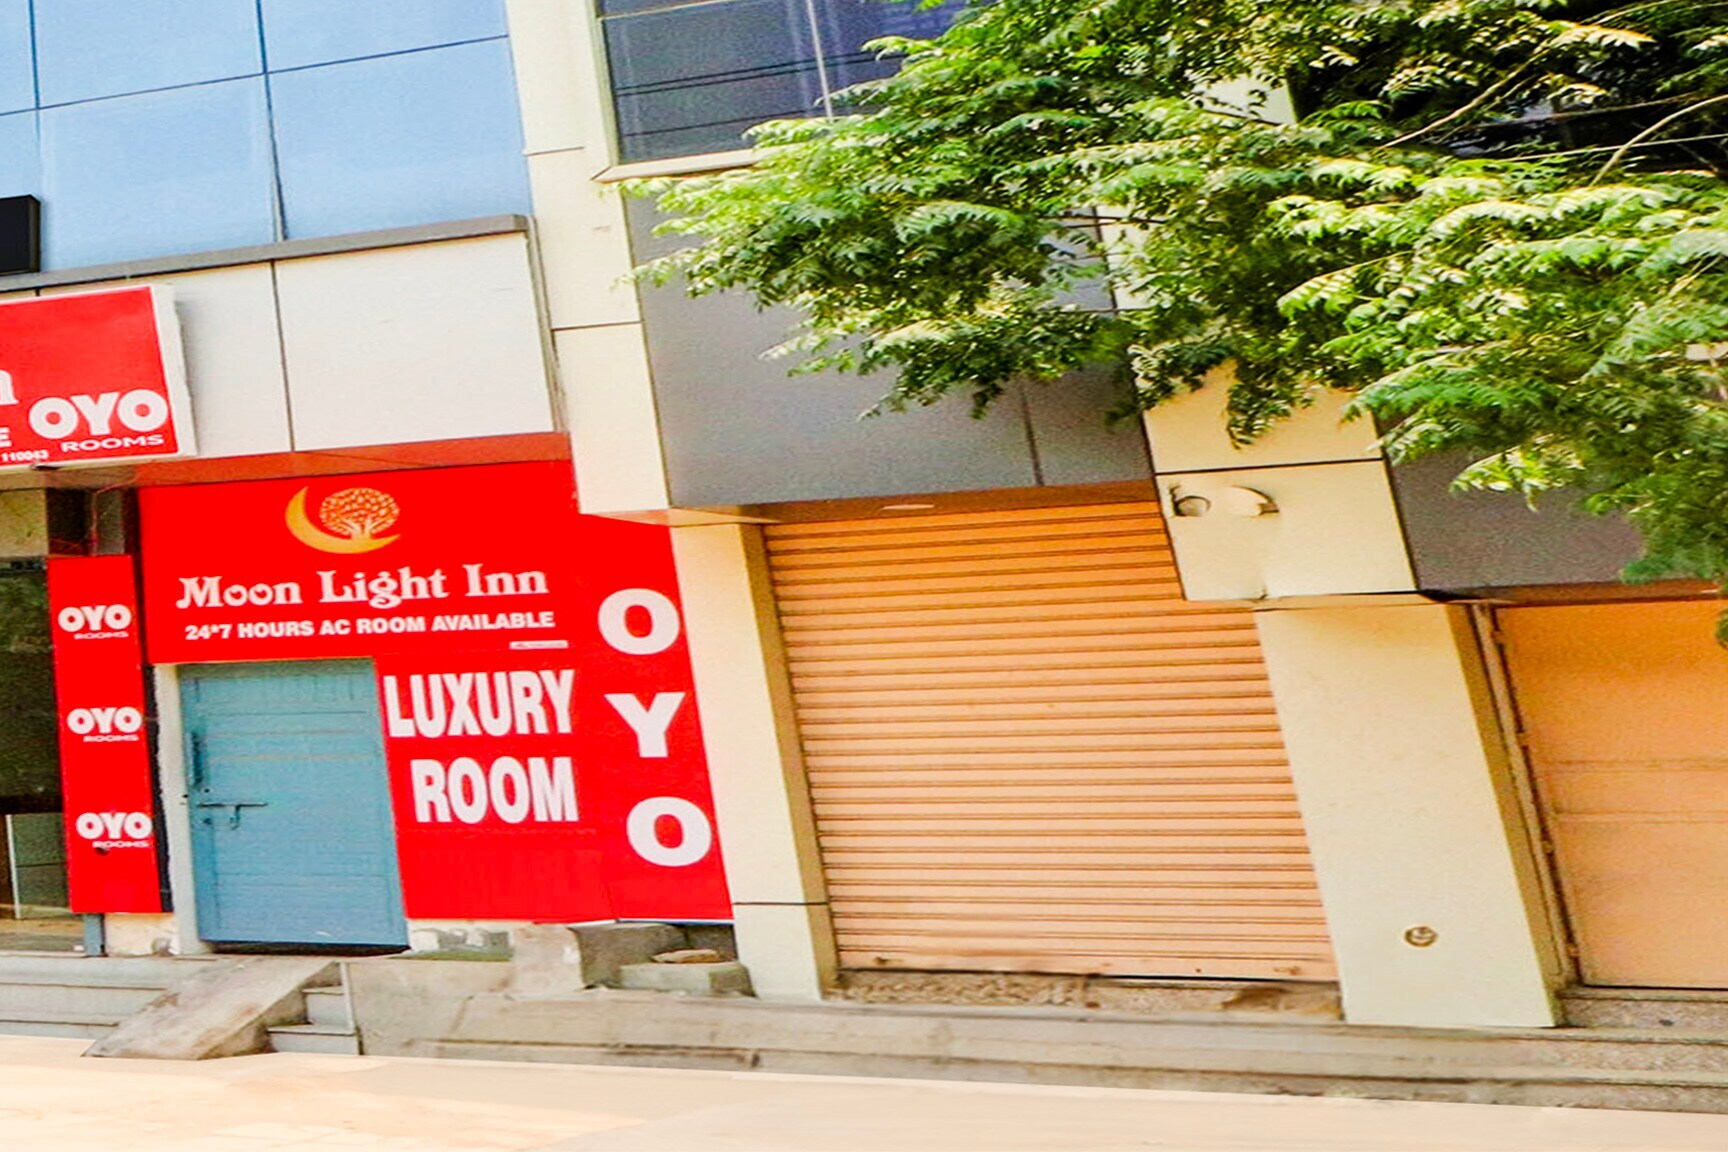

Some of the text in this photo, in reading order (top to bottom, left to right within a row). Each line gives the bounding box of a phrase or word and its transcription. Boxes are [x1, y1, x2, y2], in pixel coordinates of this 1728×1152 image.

[28, 389, 169, 440] OYO
[1, 449, 49, 462] 110043
[61, 434, 164, 452] ROOMS
[175, 563, 550, 609] Moon Light Inn
[58, 604, 132, 632] OYO
[238, 619, 314, 639] HOURS
[319, 618, 351, 636] AC
[356, 616, 426, 634] ROOM
[431, 611, 556, 632] AVAILABLE
[73, 631, 129, 640] ROOMS
[383, 668, 576, 738] LUXURY
[67, 706, 143, 735] OYO
[596, 587, 713, 867] OYO
[83, 734, 139, 743] ROOMS
[410, 756, 579, 824] ROOM
[76, 811, 154, 840] OYO
[92, 840, 149, 849] ROOMS
